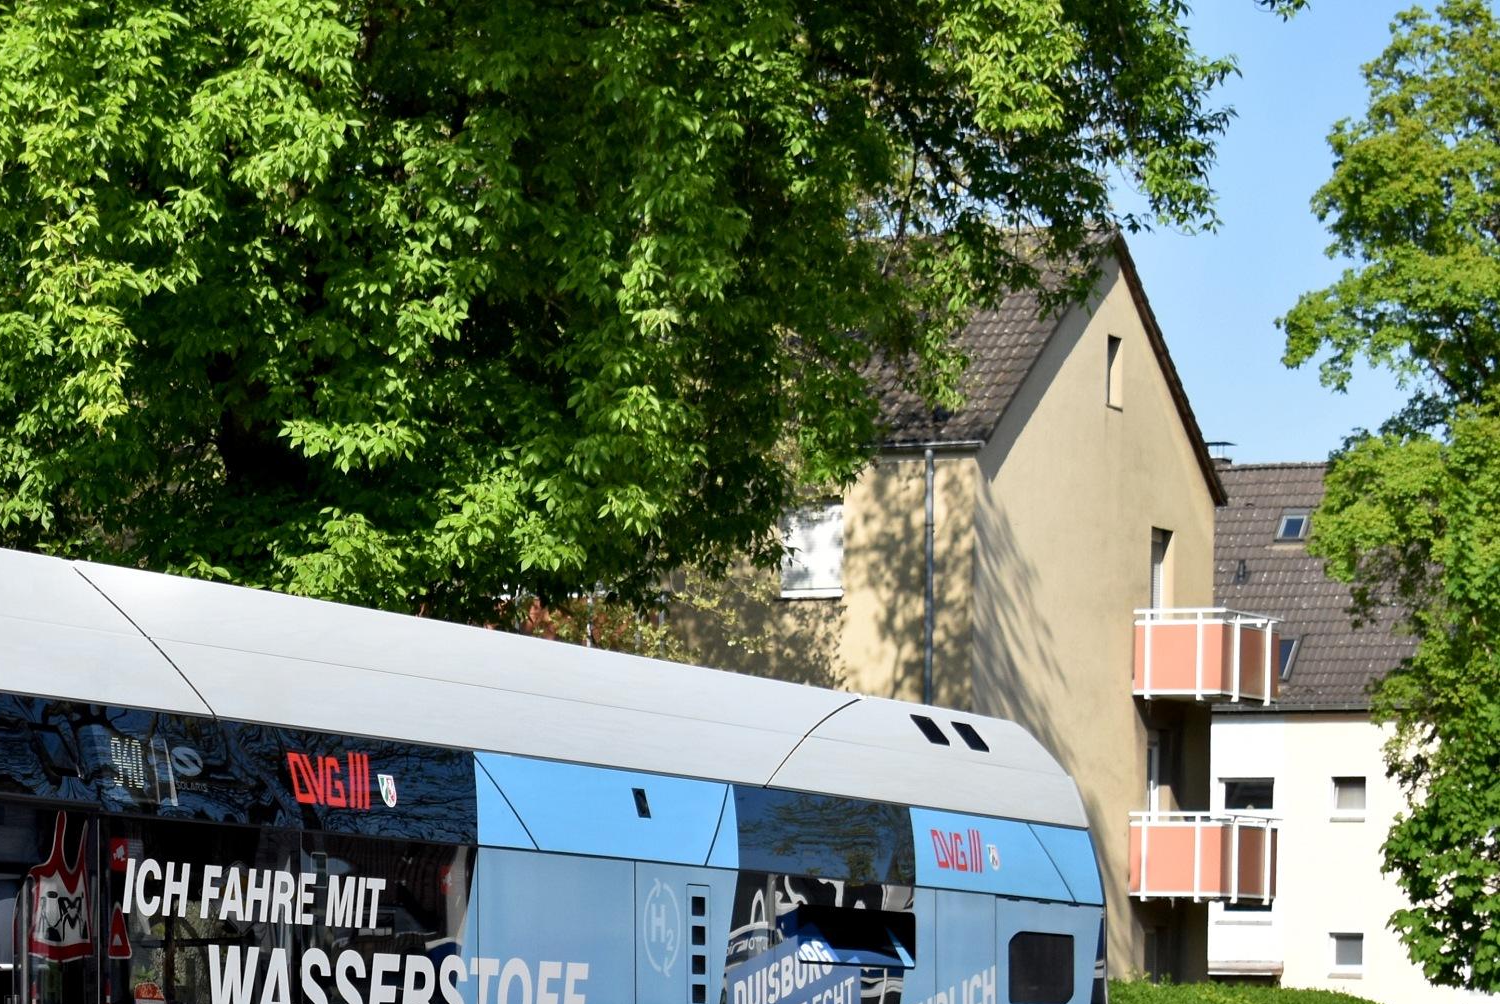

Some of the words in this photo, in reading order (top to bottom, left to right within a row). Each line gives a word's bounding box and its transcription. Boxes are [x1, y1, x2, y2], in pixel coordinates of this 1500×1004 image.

[111, 737, 144, 789] 940
[287, 752, 347, 808] DVG
[930, 829, 968, 872] DVG
[122, 858, 190, 917] ICH
[200, 864, 317, 926] FAHRE
[325, 875, 387, 929] MIT
